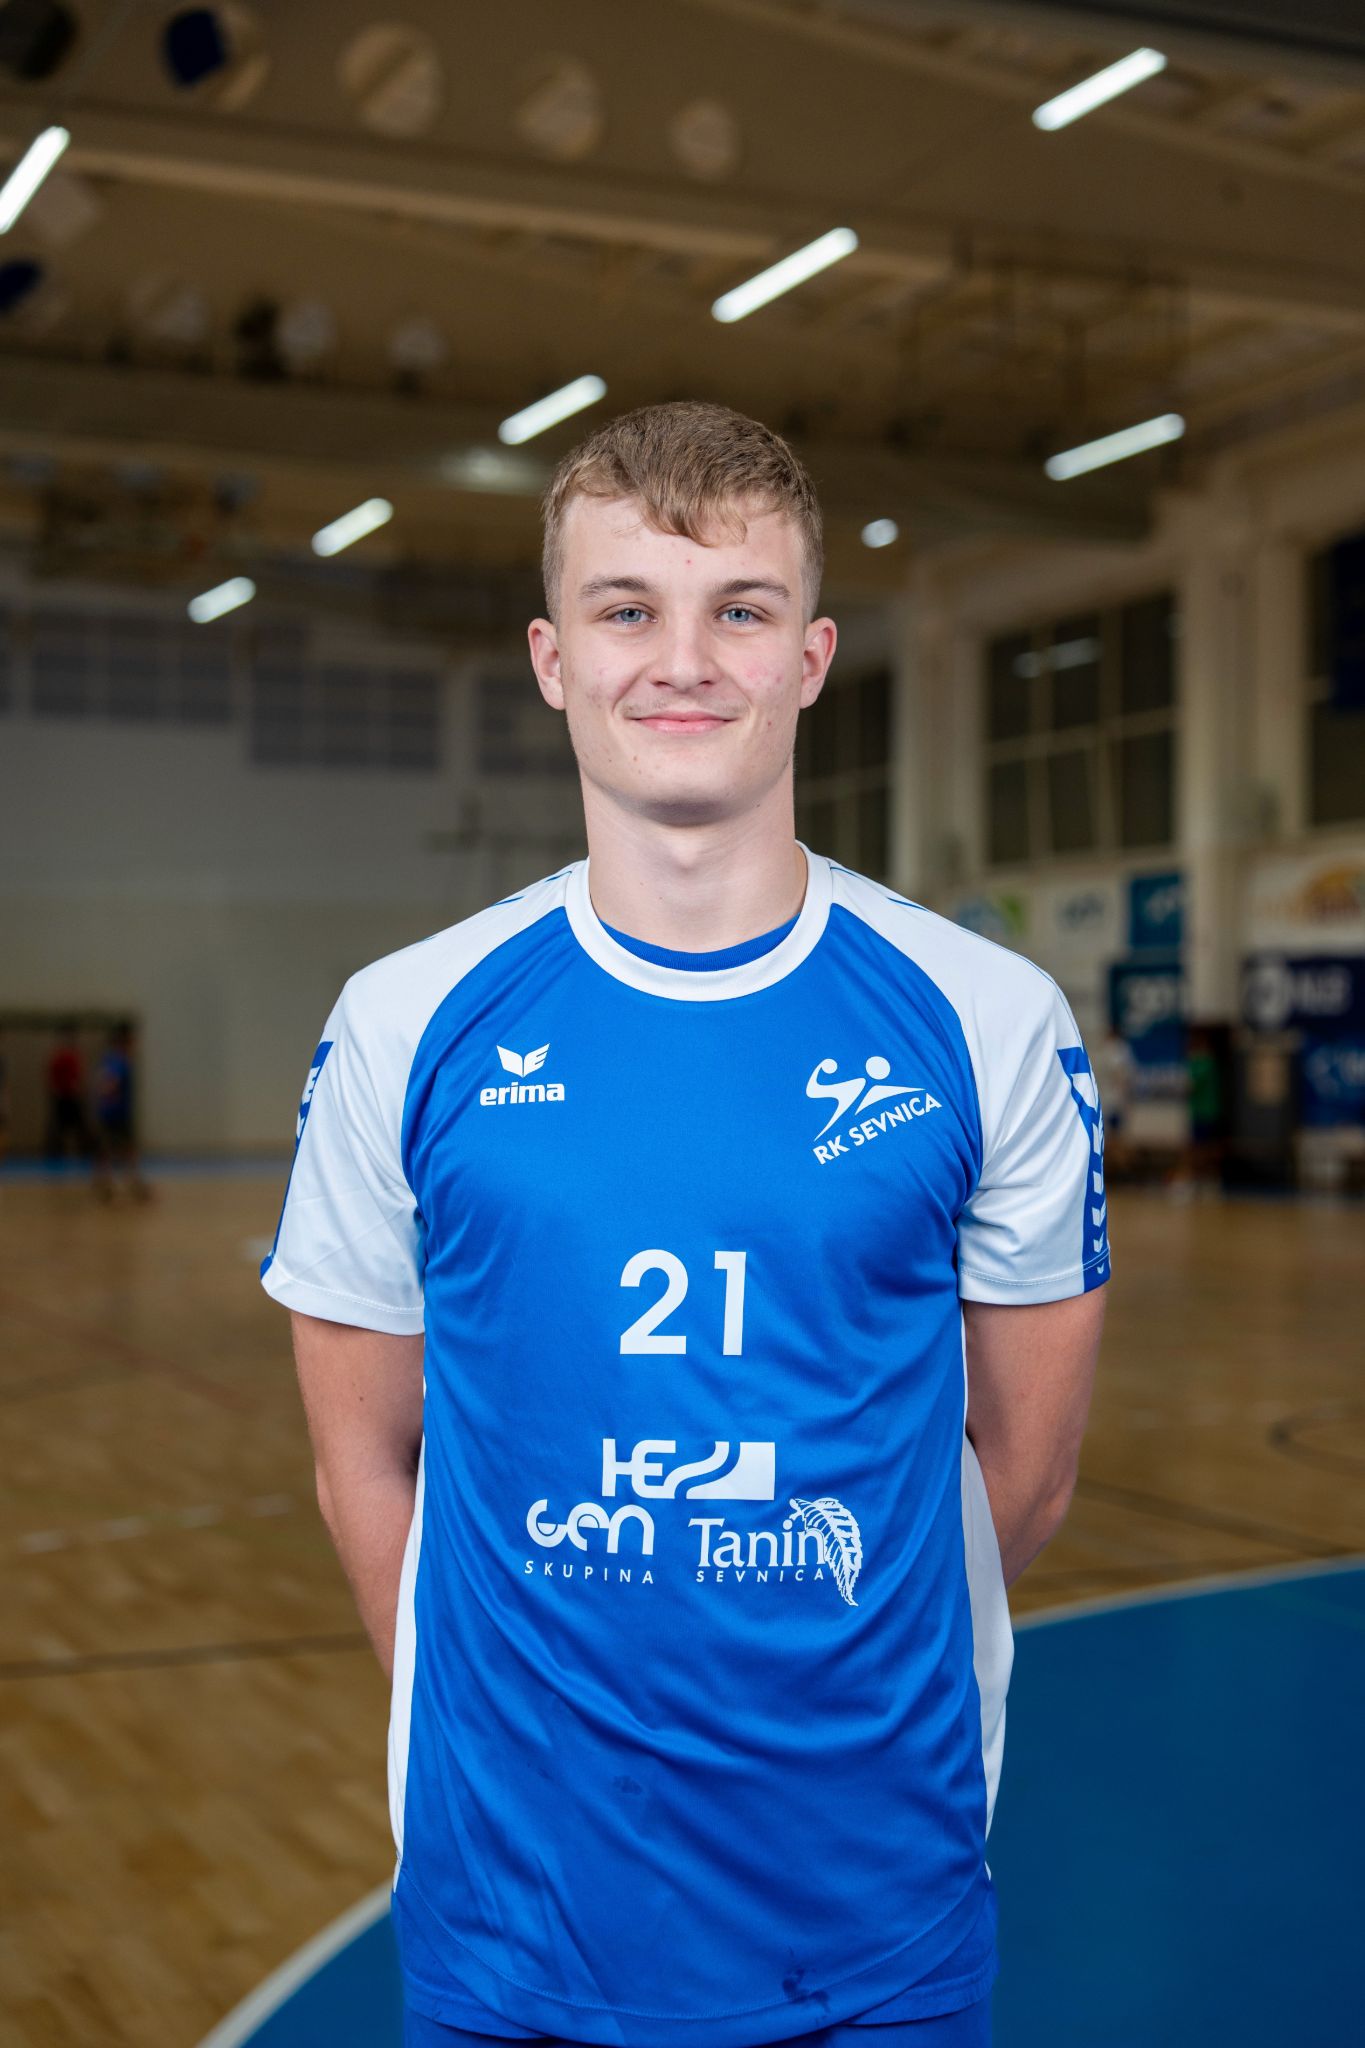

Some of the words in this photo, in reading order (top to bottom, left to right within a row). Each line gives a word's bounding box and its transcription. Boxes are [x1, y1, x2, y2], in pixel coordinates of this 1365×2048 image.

[480, 1082, 565, 1105] erima
[813, 1135, 850, 1165] RK
[848, 1092, 942, 1146] SEVNICA
[620, 1249, 747, 1355] 21
[688, 1518, 826, 1568] Tanin
[525, 1560, 654, 1584] SKUPINA
[696, 1568, 824, 1583] SEVNICA
